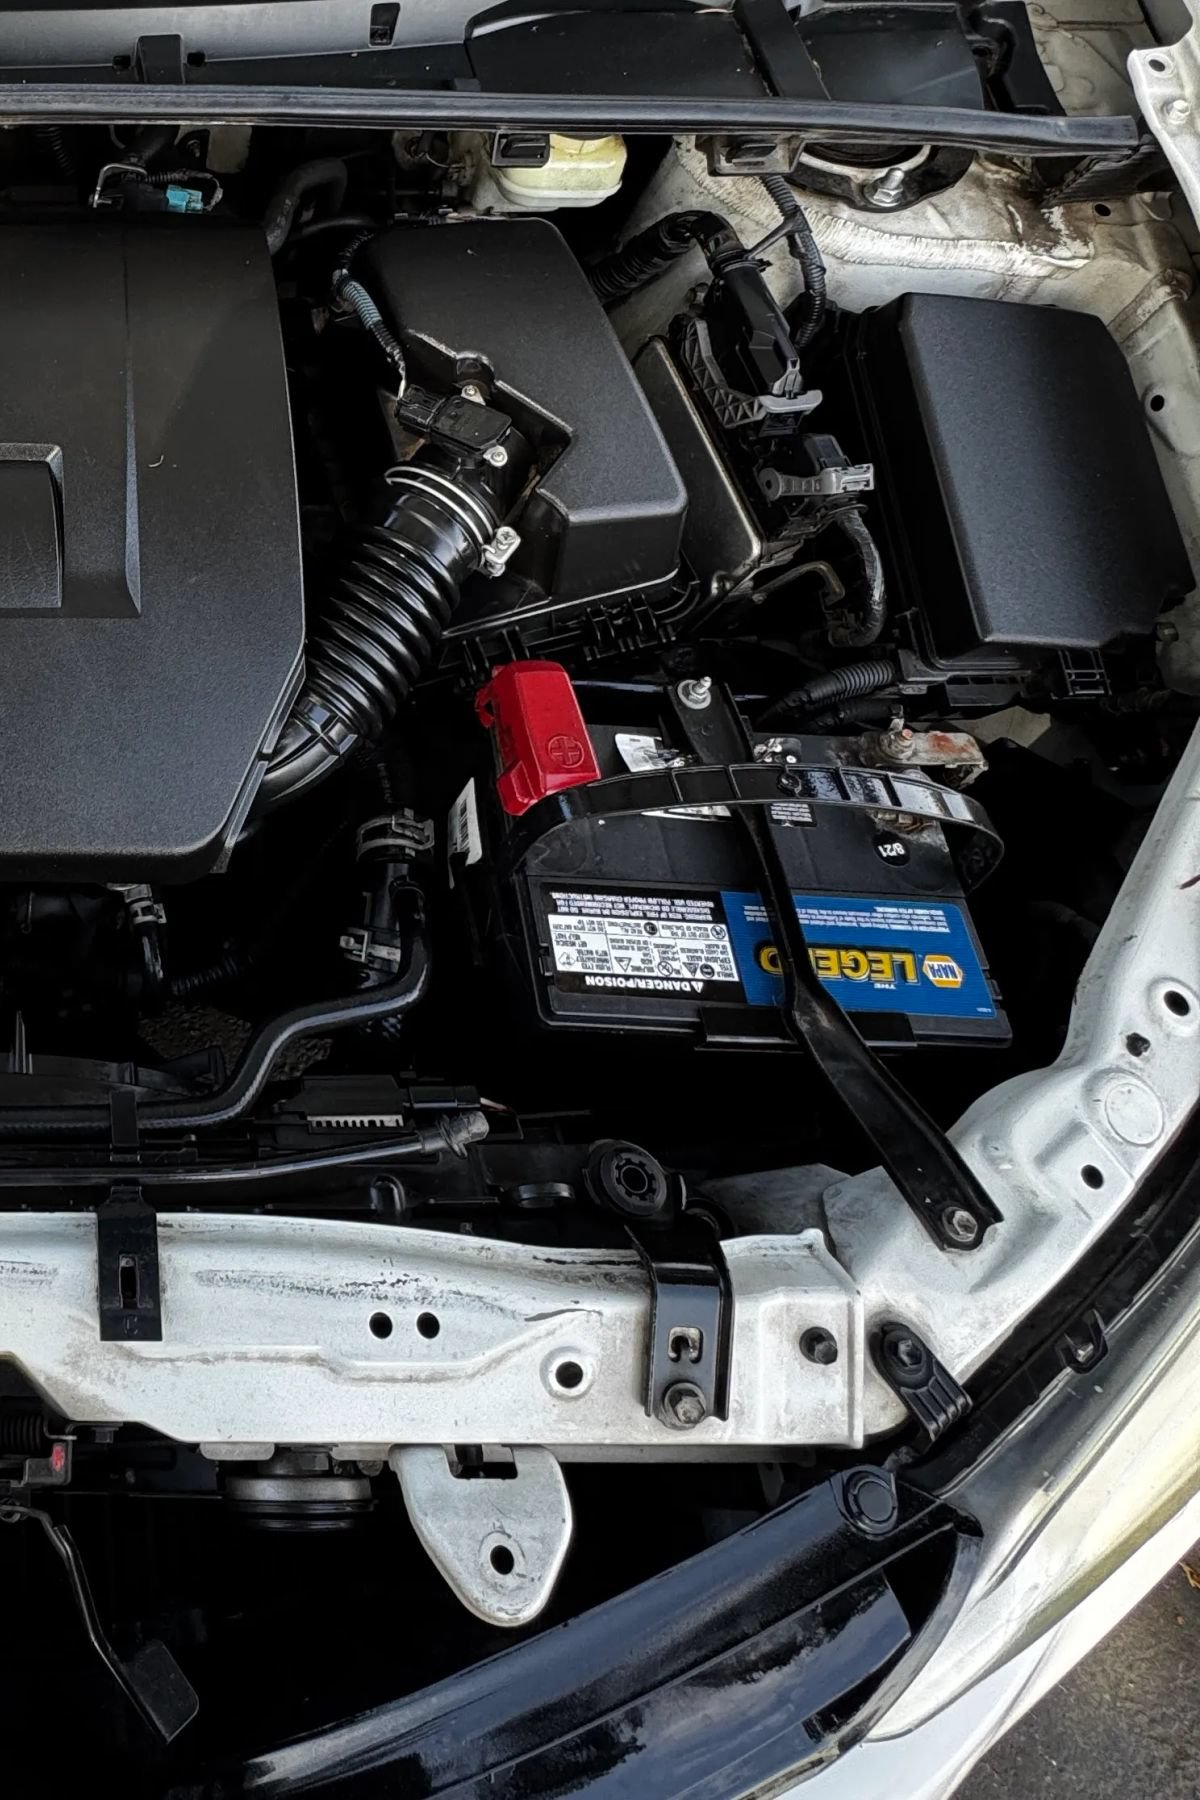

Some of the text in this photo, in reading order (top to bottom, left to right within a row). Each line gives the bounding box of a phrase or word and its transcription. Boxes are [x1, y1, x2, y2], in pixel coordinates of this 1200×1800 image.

[878, 843, 905, 857] 8/21
[758, 945, 919, 984] LEGED
[927, 963, 957, 980] NAPA
[585, 975, 691, 992] DANGER/POISON
